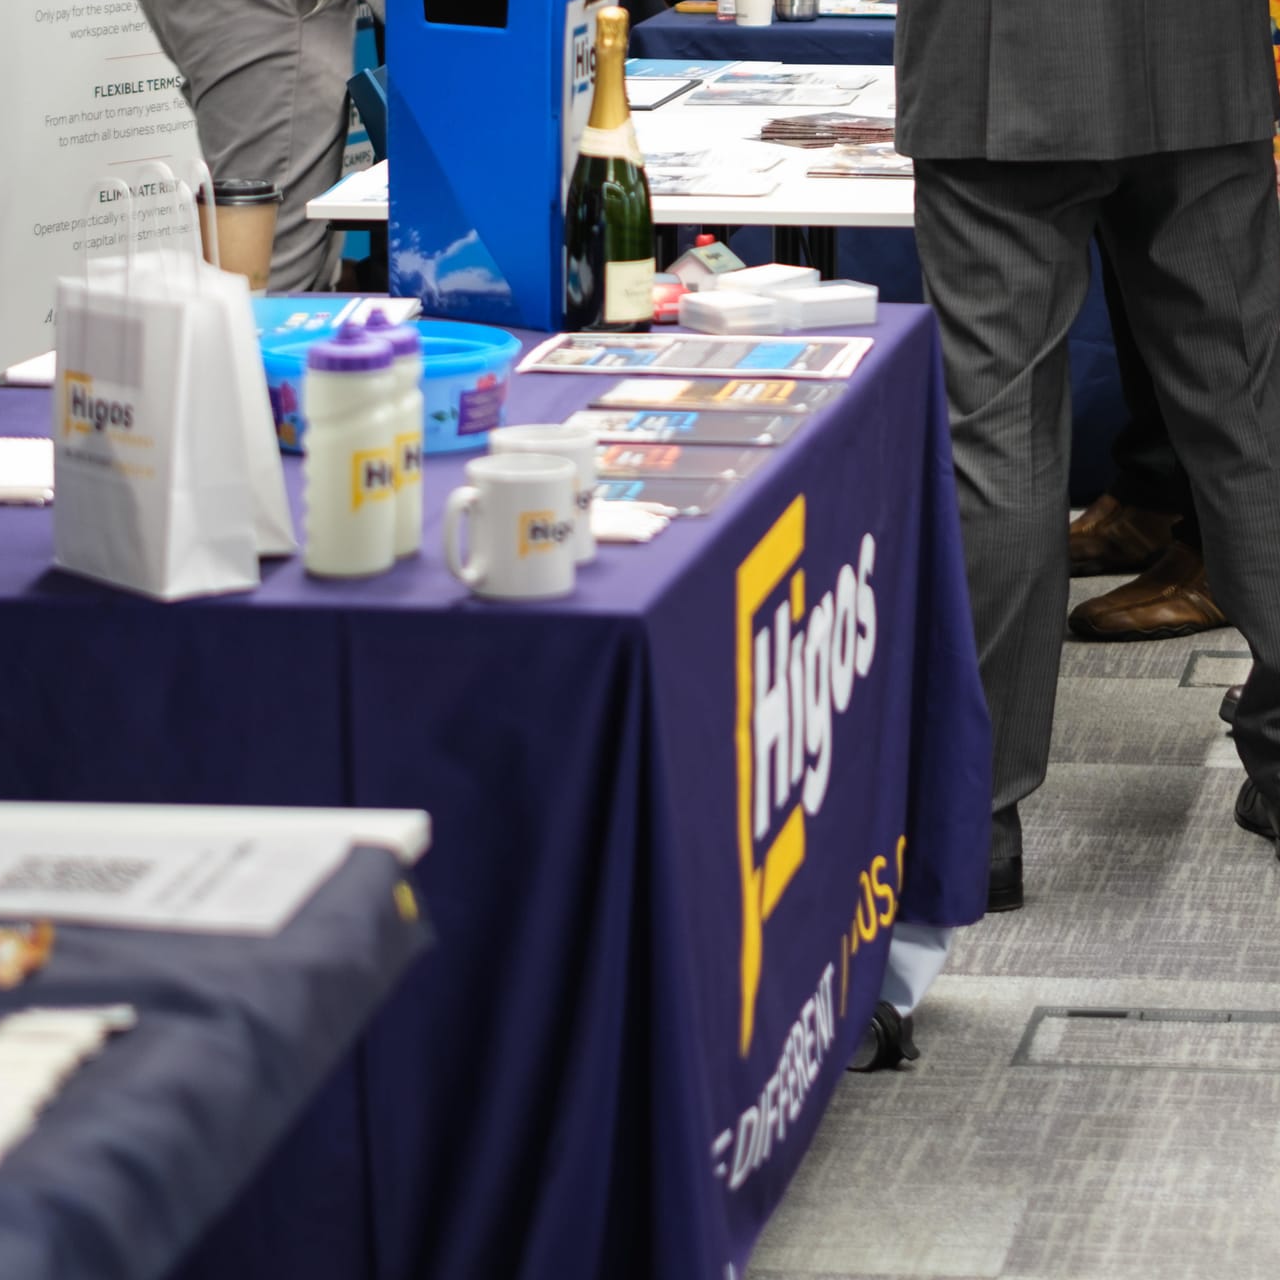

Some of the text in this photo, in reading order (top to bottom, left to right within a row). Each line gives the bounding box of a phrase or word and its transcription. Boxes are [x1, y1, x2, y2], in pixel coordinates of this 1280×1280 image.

[71, 4, 84, 18] for
[86, 3, 102, 16] the
[104, 1, 132, 18] space
[70, 24, 120, 40] workspace
[94, 75, 182, 99] FLEXIBLE TERMS
[45, 114, 68, 128] From
[81, 109, 102, 122] hour
[105, 108, 116, 120] to
[117, 105, 144, 120] many
[59, 136, 69, 147] to
[70, 131, 100, 146] match
[101, 129, 112, 142] all
[113, 123, 156, 140] business
[33, 219, 70, 237] Operate
[72, 383, 134, 432] Higos
[754, 532, 877, 842] Higos
[728, 960, 835, 1191] DIFFERENT
